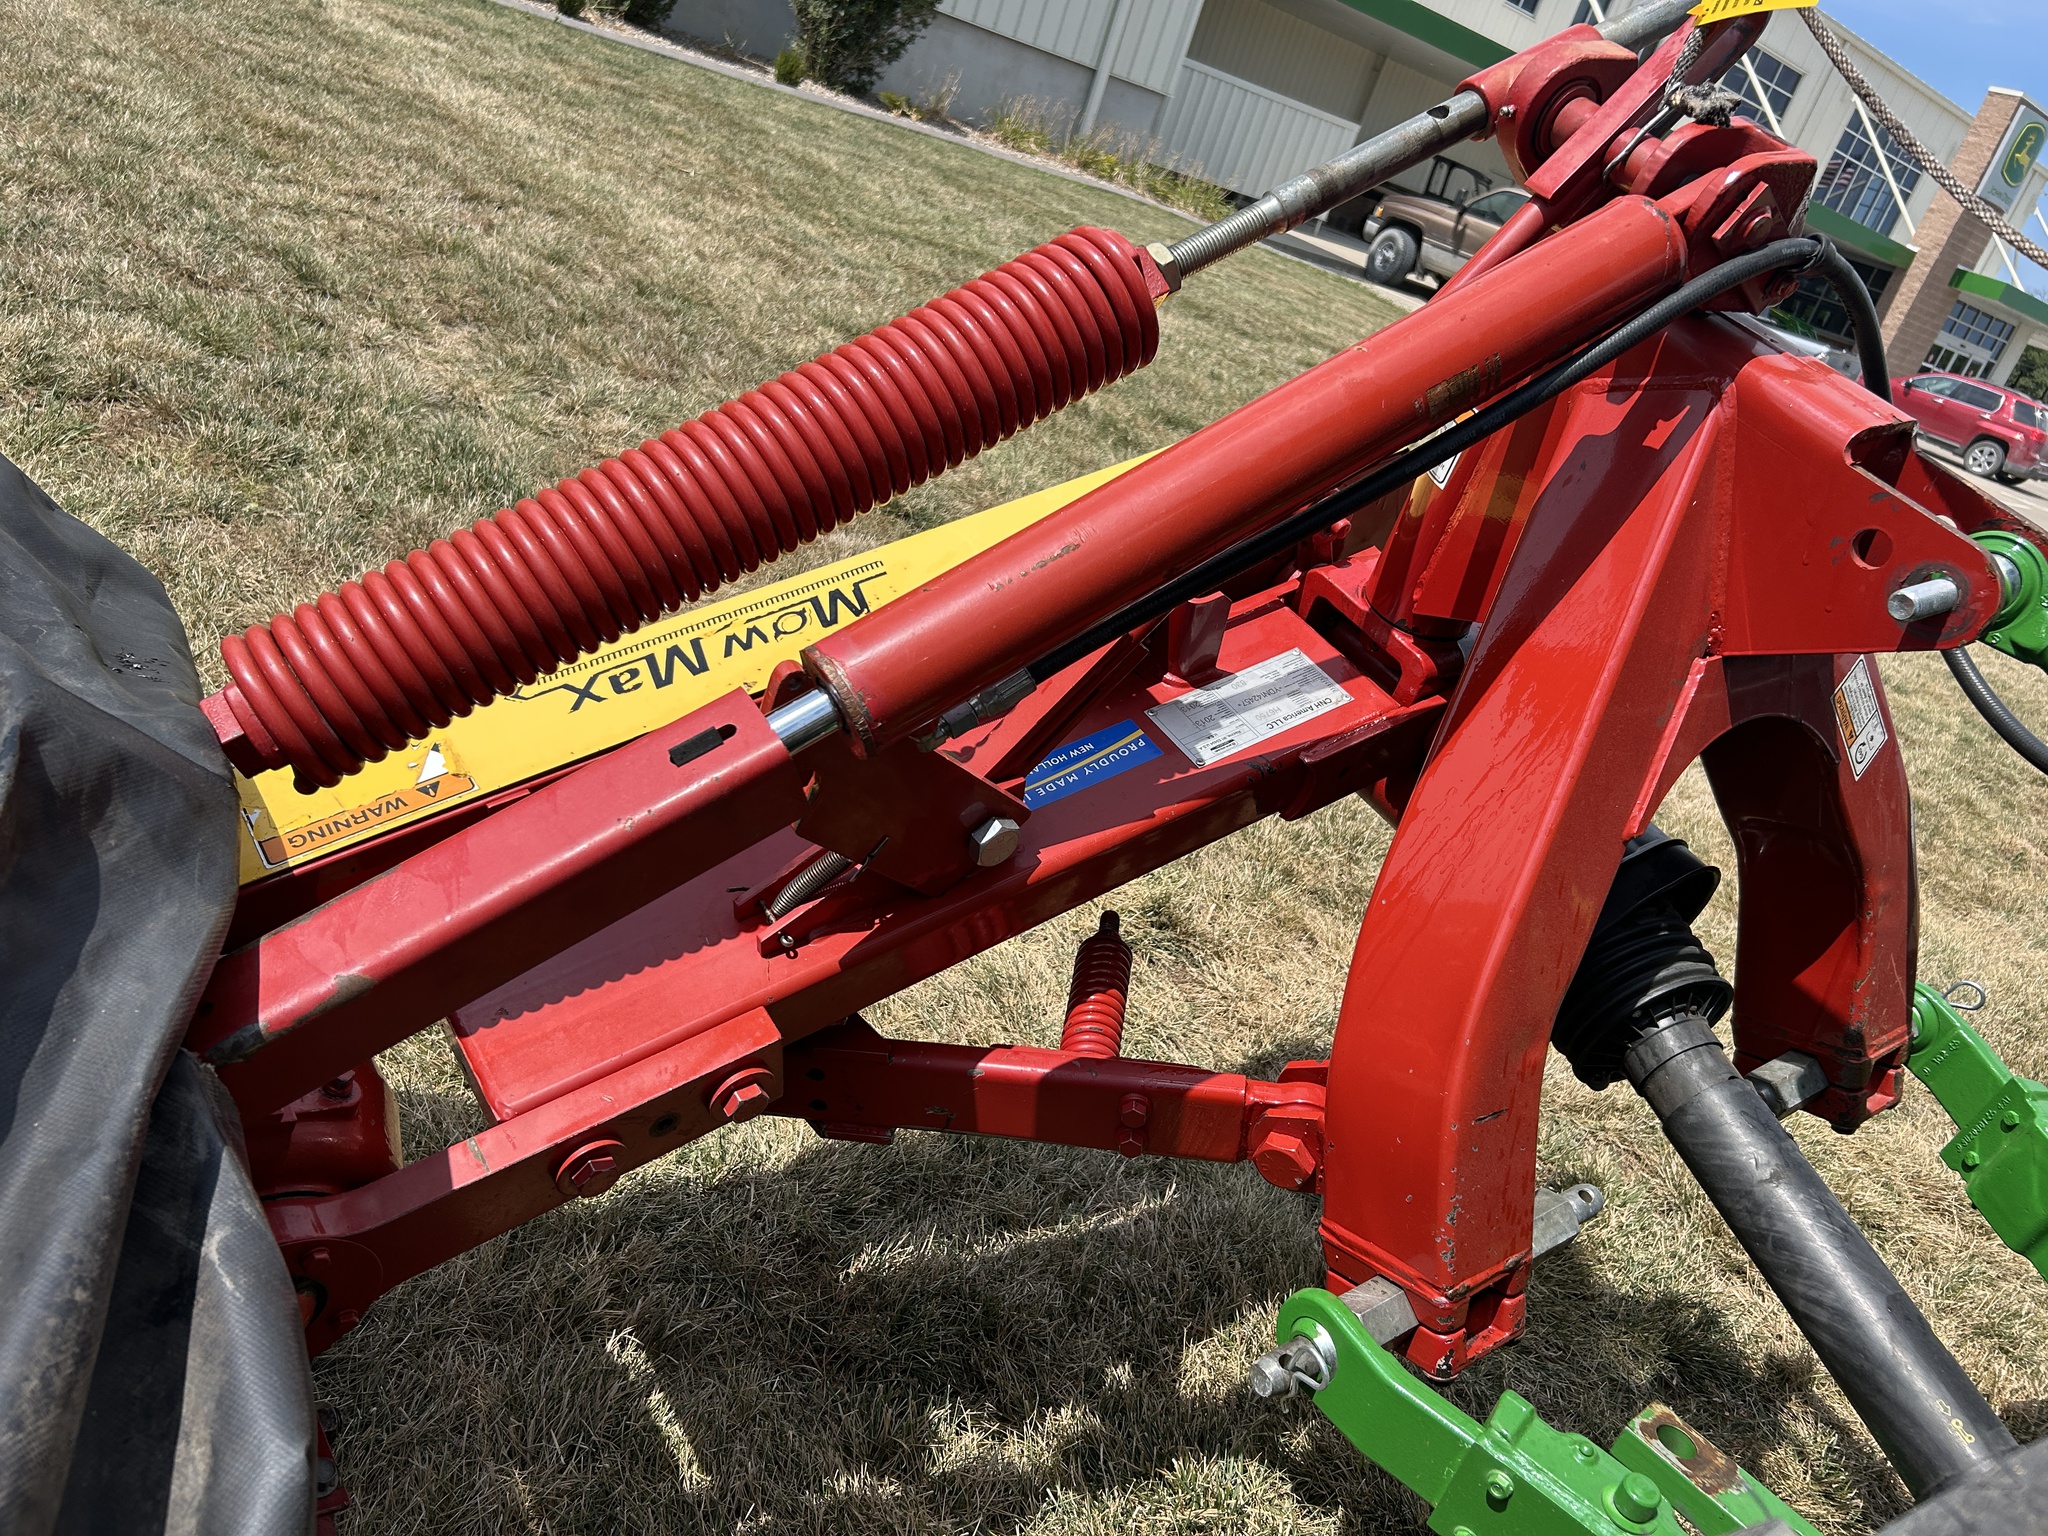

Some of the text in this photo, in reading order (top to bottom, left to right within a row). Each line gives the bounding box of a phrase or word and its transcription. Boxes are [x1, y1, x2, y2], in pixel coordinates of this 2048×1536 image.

[561, 582, 871, 713] Mow Max
[1178, 699, 1200, 713] 2013
[1193, 713, 1216, 727] 2013
[1264, 697, 1333, 730] CNH America LLC
[1069, 741, 1095, 758] NEW
[1084, 738, 1146, 776] PROUDLY
[1035, 771, 1078, 796] MADE
[287, 796, 409, 849] WARNING
